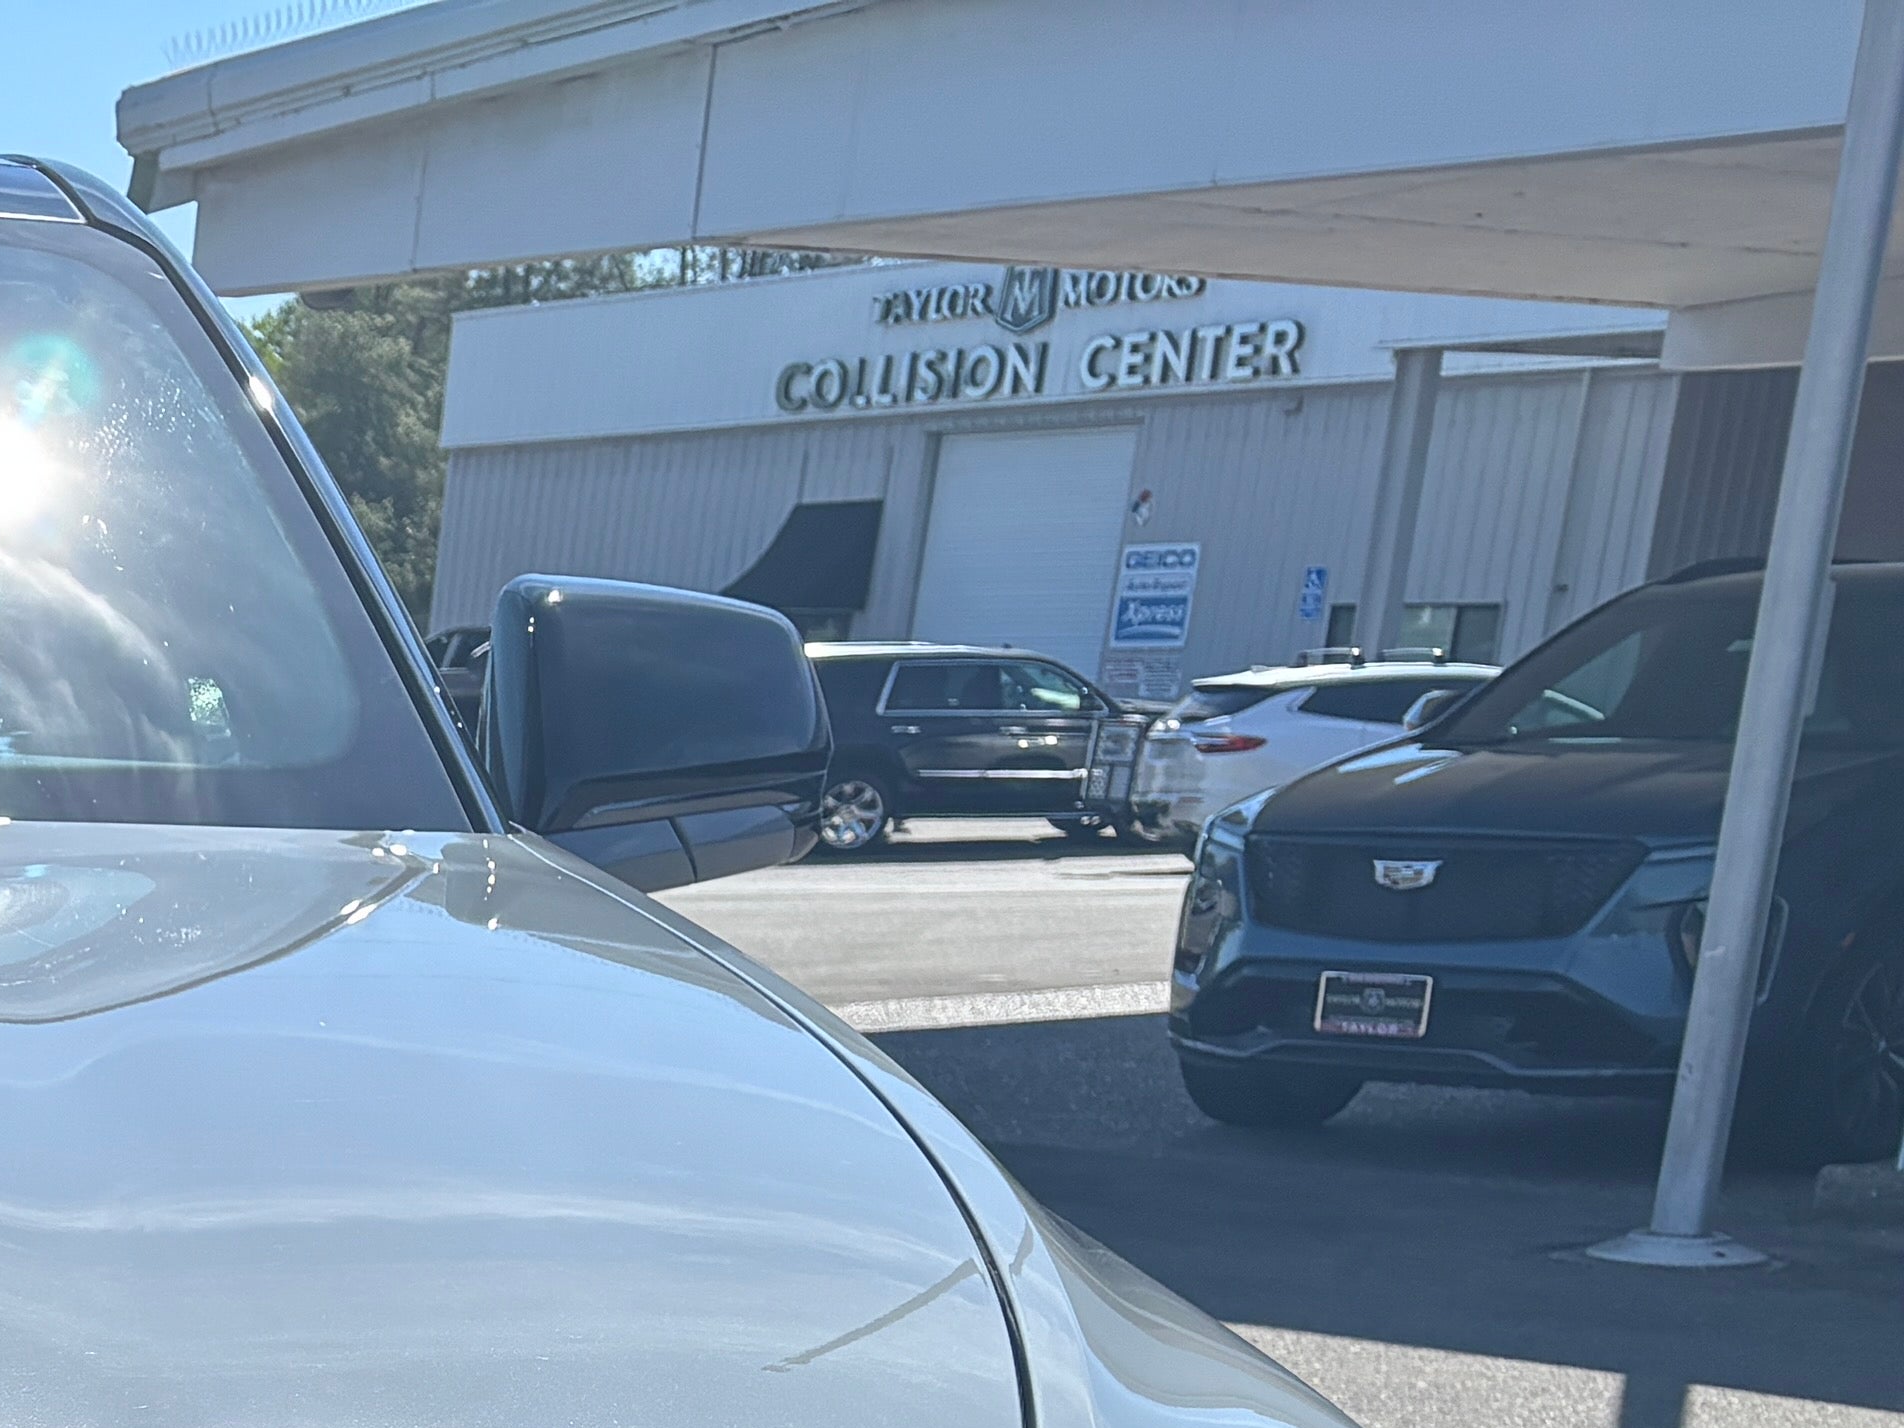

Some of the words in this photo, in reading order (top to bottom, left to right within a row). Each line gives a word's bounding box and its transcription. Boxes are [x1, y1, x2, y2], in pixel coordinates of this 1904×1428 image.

[873, 281, 993, 323] TAYLOR
[776, 340, 1050, 414] COLLISION
[1079, 319, 1306, 390] CENTER
[1126, 548, 1196, 569] GEICO
